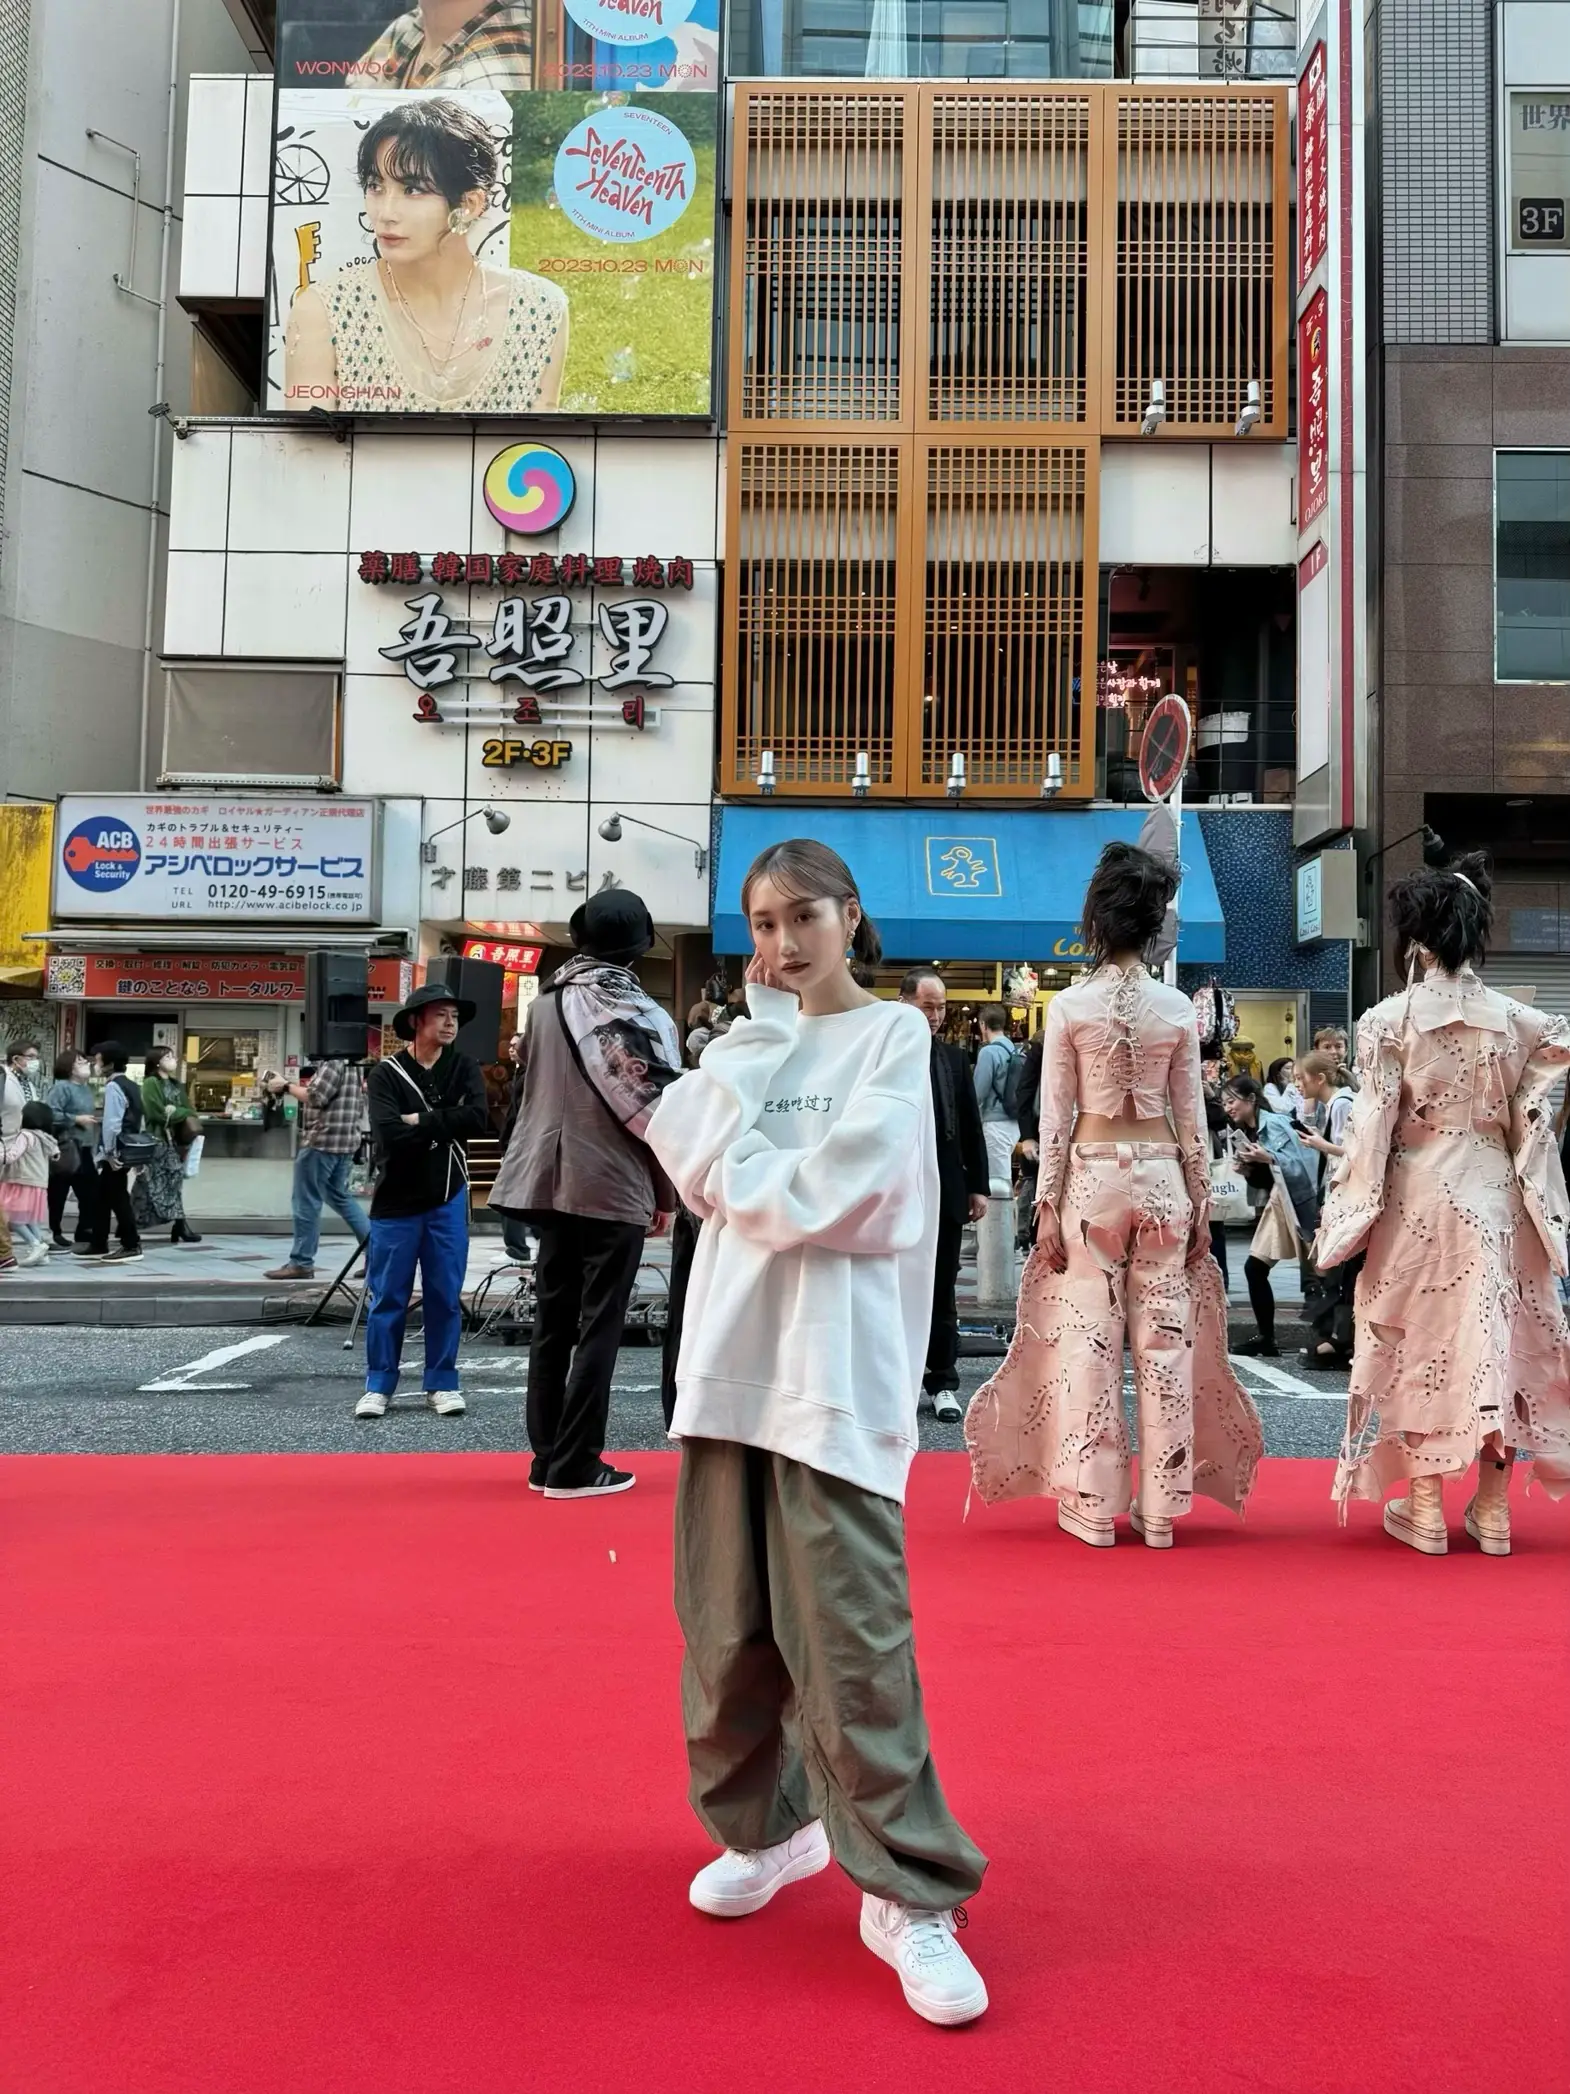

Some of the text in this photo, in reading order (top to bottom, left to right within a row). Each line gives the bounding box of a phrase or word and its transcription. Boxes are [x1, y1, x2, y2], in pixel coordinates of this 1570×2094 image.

[599, 0, 663, 26] eaven
[598, 30, 617, 41] MINI
[617, 32, 649, 42] ALBUM
[295, 60, 399, 76] WONWOO
[543, 63, 708, 79] 2023.10.23 MON
[623, 112, 673, 136] SEVENTEEN
[1519, 104, 1570, 131] 世界
[575, 167, 655, 226] Heaven
[1521, 206, 1563, 234] 3F
[586, 221, 604, 234] MINI
[603, 230, 636, 239] ALBUM
[538, 259, 704, 274] 2023.10.23 MON
[284, 385, 401, 399] JEONGHAN
[358, 551, 695, 590] 薬膳 韓国家庭料理 焼肉
[96, 830, 134, 849] ACB
[145, 836, 304, 851] 24時間出張サービス
[95, 861, 116, 870] Lock
[144, 855, 364, 879] アシベロックサービス
[94, 870, 131, 880] Security
[173, 887, 194, 896] TEL
[208, 884, 326, 900] 0120-49-6915
[171, 901, 193, 909] URL
[116, 978, 210, 997] 鍵のことなら
[764, 1095, 833, 1113] 已经吃过了
